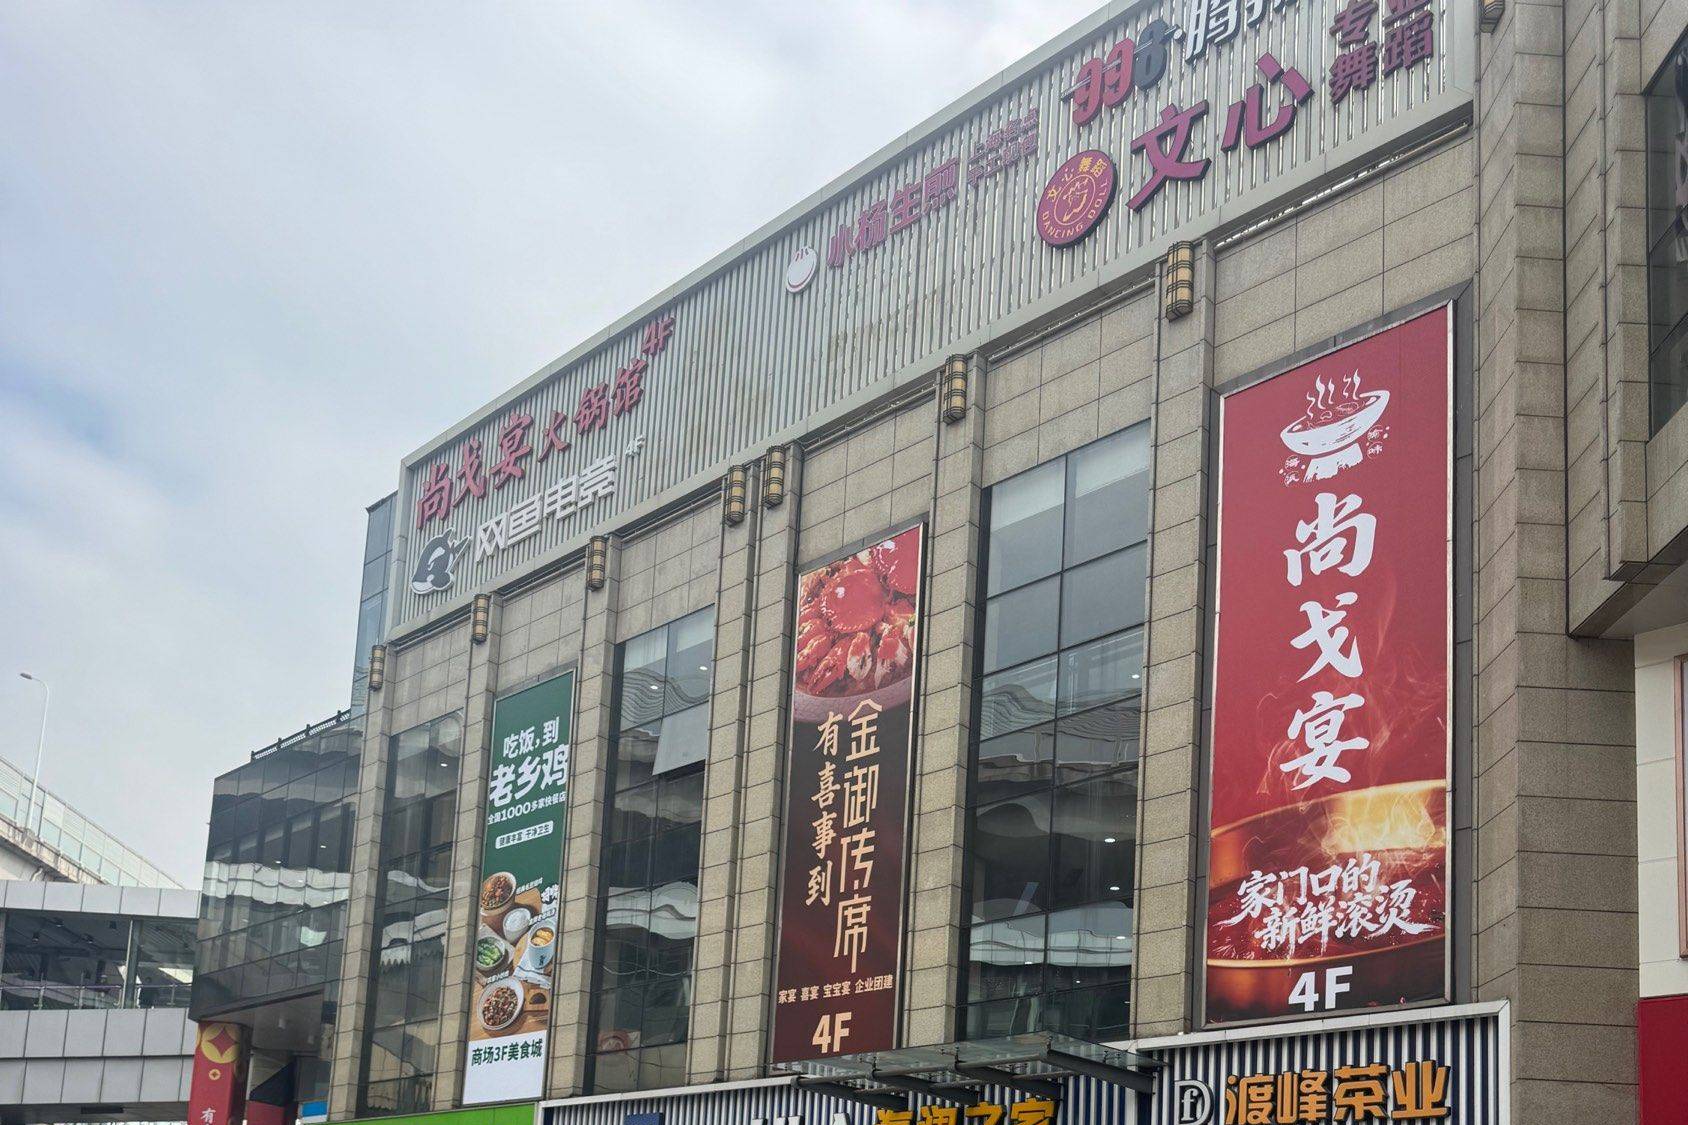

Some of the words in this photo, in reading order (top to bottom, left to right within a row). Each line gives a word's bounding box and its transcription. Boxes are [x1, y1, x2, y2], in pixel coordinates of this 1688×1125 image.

[1329, 10, 1433, 104] 舞蹈
[1126, 53, 1315, 213] 文心
[826, 156, 960, 270] 小杨生煎
[1042, 210, 1084, 239] DANCING
[1088, 178, 1109, 220] DOLL
[641, 315, 676, 356] 4F
[1279, 492, 1378, 791] 尚戈宴
[489, 743, 570, 808] 老乡鸡
[805, 711, 844, 907] 有喜事到
[1214, 853, 1382, 929] 家门口的
[1254, 879, 1441, 960] 新鲜滚烫
[823, 980, 851, 999] 宝宝宴
[854, 974, 894, 994] 企业团建
[1287, 965, 1353, 1013] 4F
[471, 1038, 543, 1067] 商场3F美食城
[811, 1011, 852, 1055] 4F
